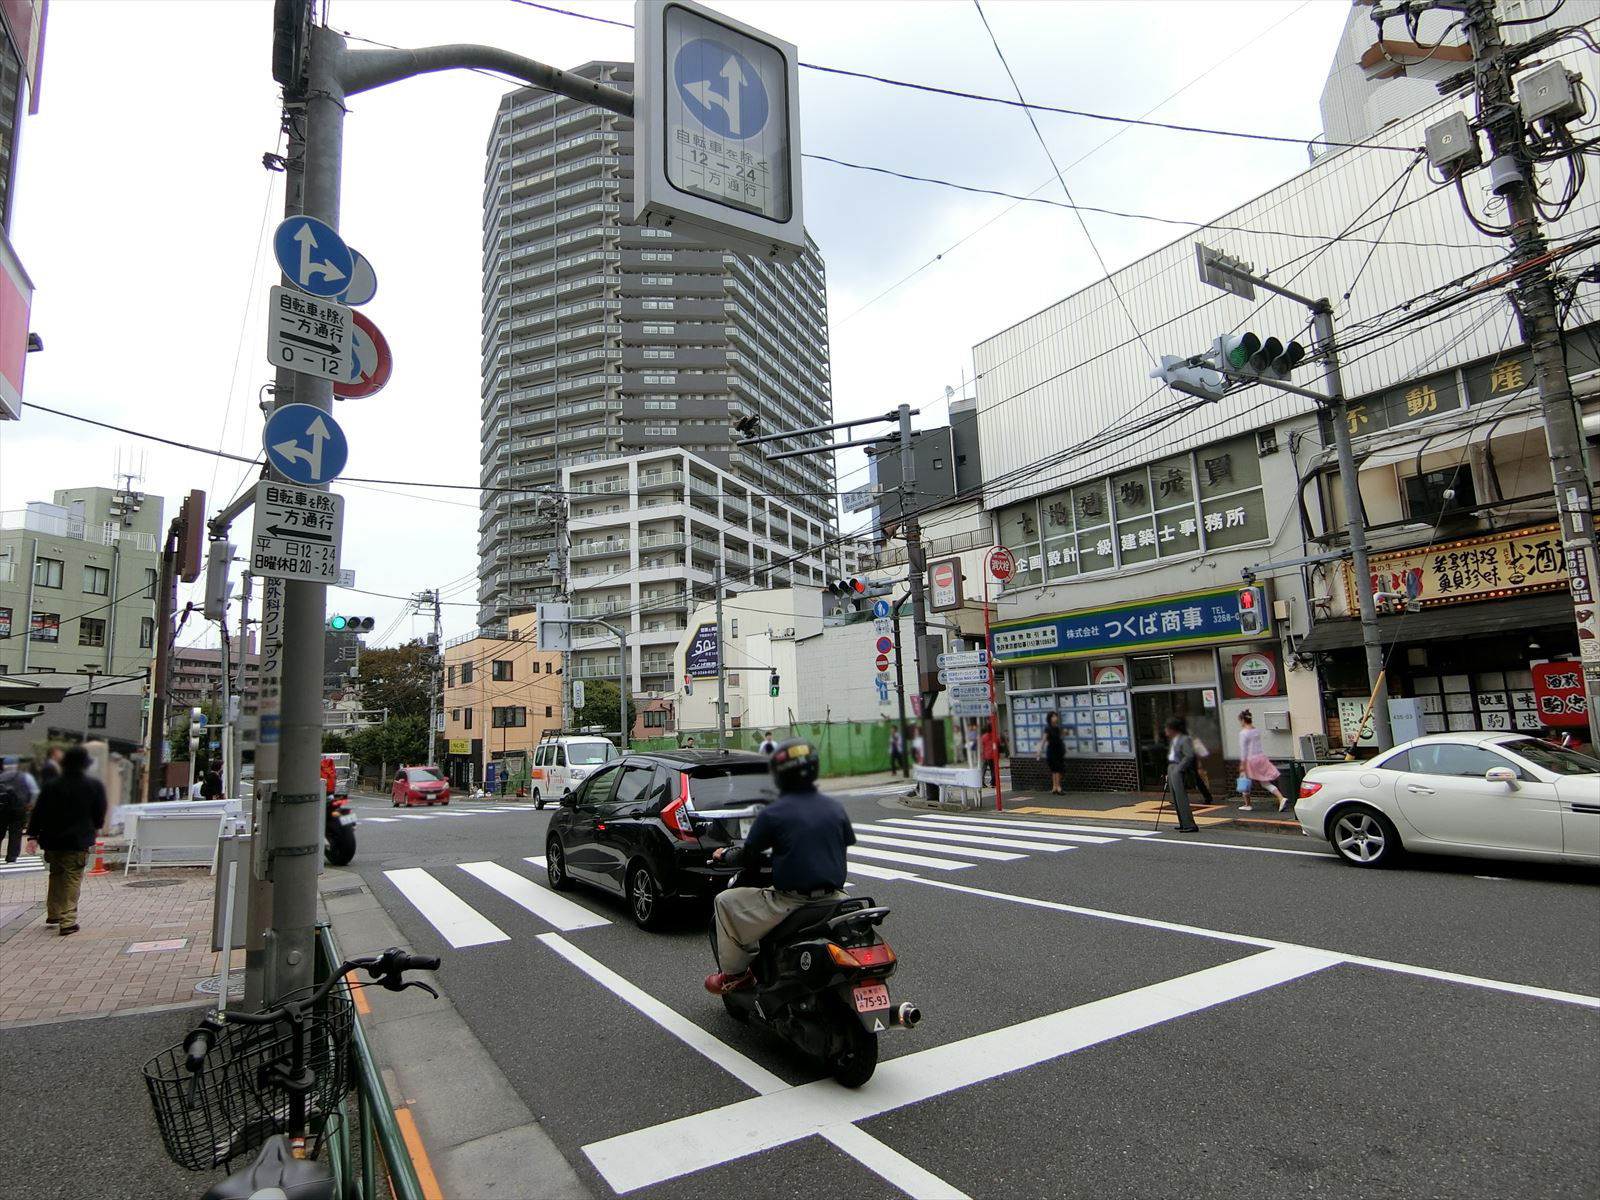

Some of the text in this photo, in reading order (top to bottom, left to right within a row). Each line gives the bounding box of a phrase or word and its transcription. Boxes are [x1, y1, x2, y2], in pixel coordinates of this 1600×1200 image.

[677, 129, 768, 171] 自転車を除く
[690, 169, 757, 197] 一方通行
[280, 294, 344, 326] 自転車を除く
[280, 317, 344, 343] 一方通行
[266, 487, 335, 512] 自転車を除く
[266, 510, 334, 530] 一方通行
[255, 554, 297, 572] 日曜休日
[992, 560, 1010, 571] 消火栓
[1066, 606, 1203, 639] 株式会社 つくば商事
[1211, 606, 1226, 615] TEL
